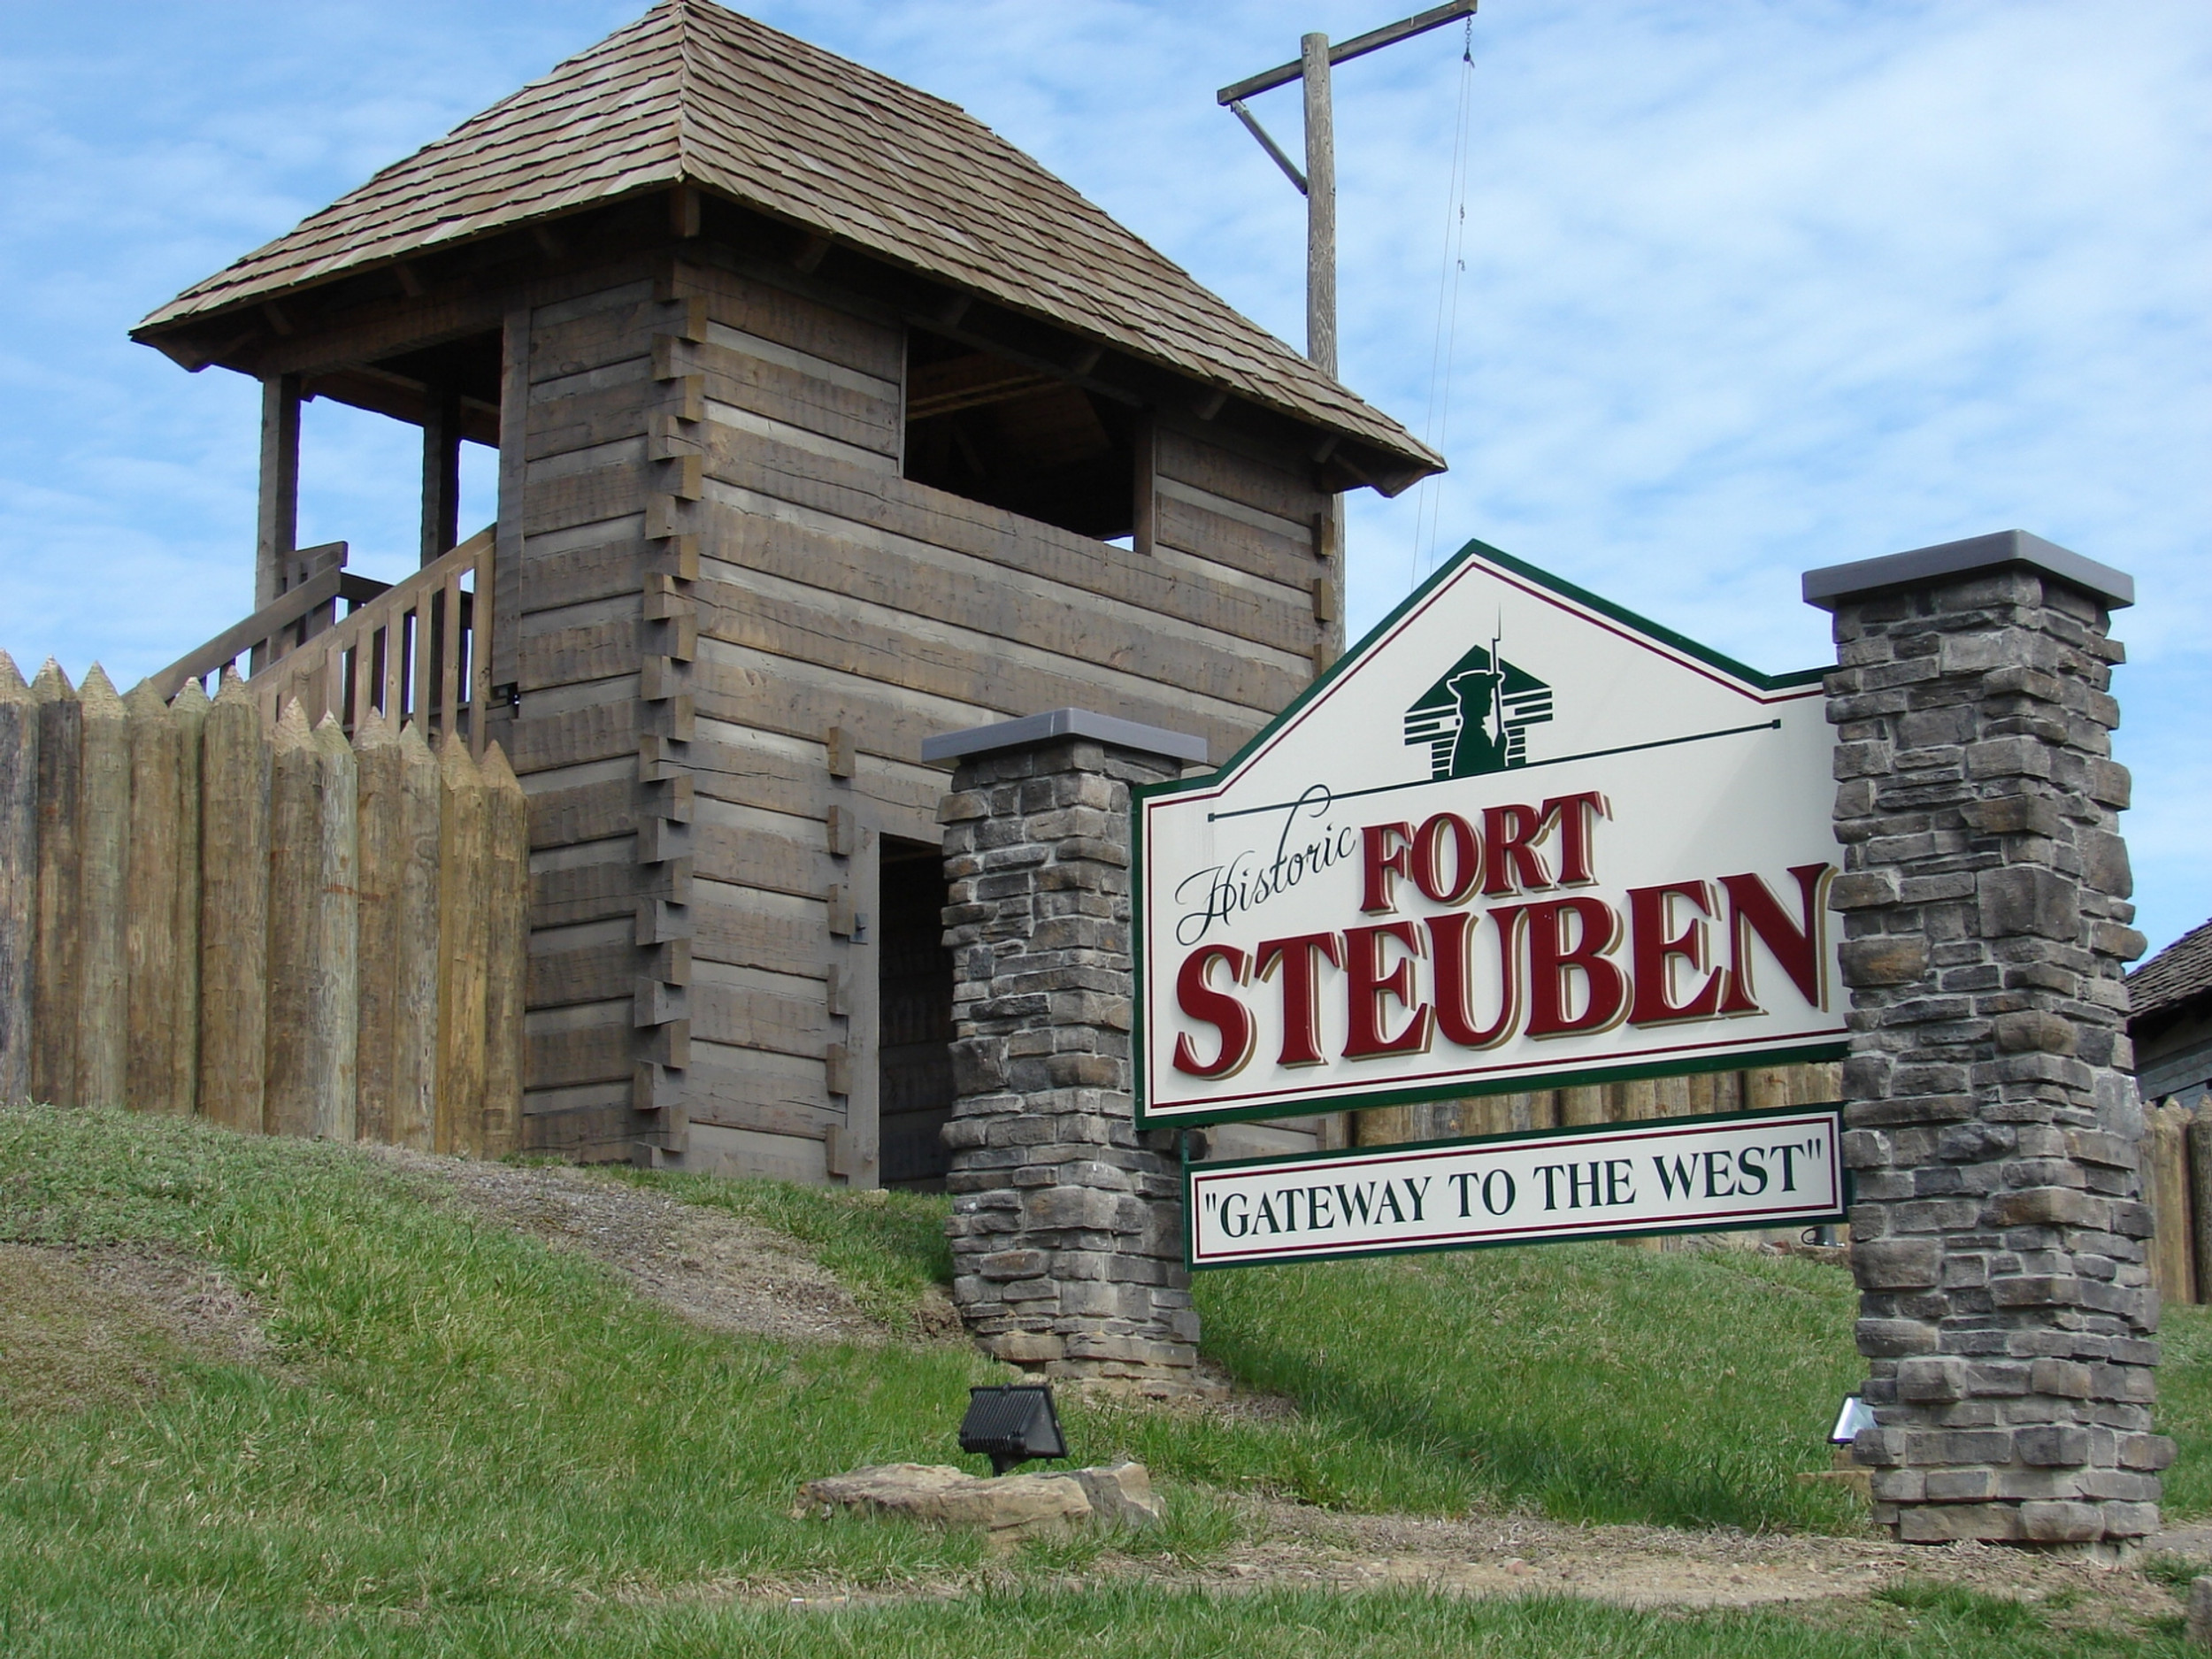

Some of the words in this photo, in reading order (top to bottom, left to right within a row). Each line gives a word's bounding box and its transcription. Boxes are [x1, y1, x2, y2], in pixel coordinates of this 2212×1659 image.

[1174, 785, 1356, 946] Historic
[1358, 790, 1614, 917] FORT
[1172, 862, 1838, 1081] STEUBEN
[1204, 1175, 1432, 1239] "GATEWAY
[1448, 1168, 1517, 1217] TO
[1533, 1157, 1637, 1211] THE
[1652, 1138, 1823, 1202] WEST"
